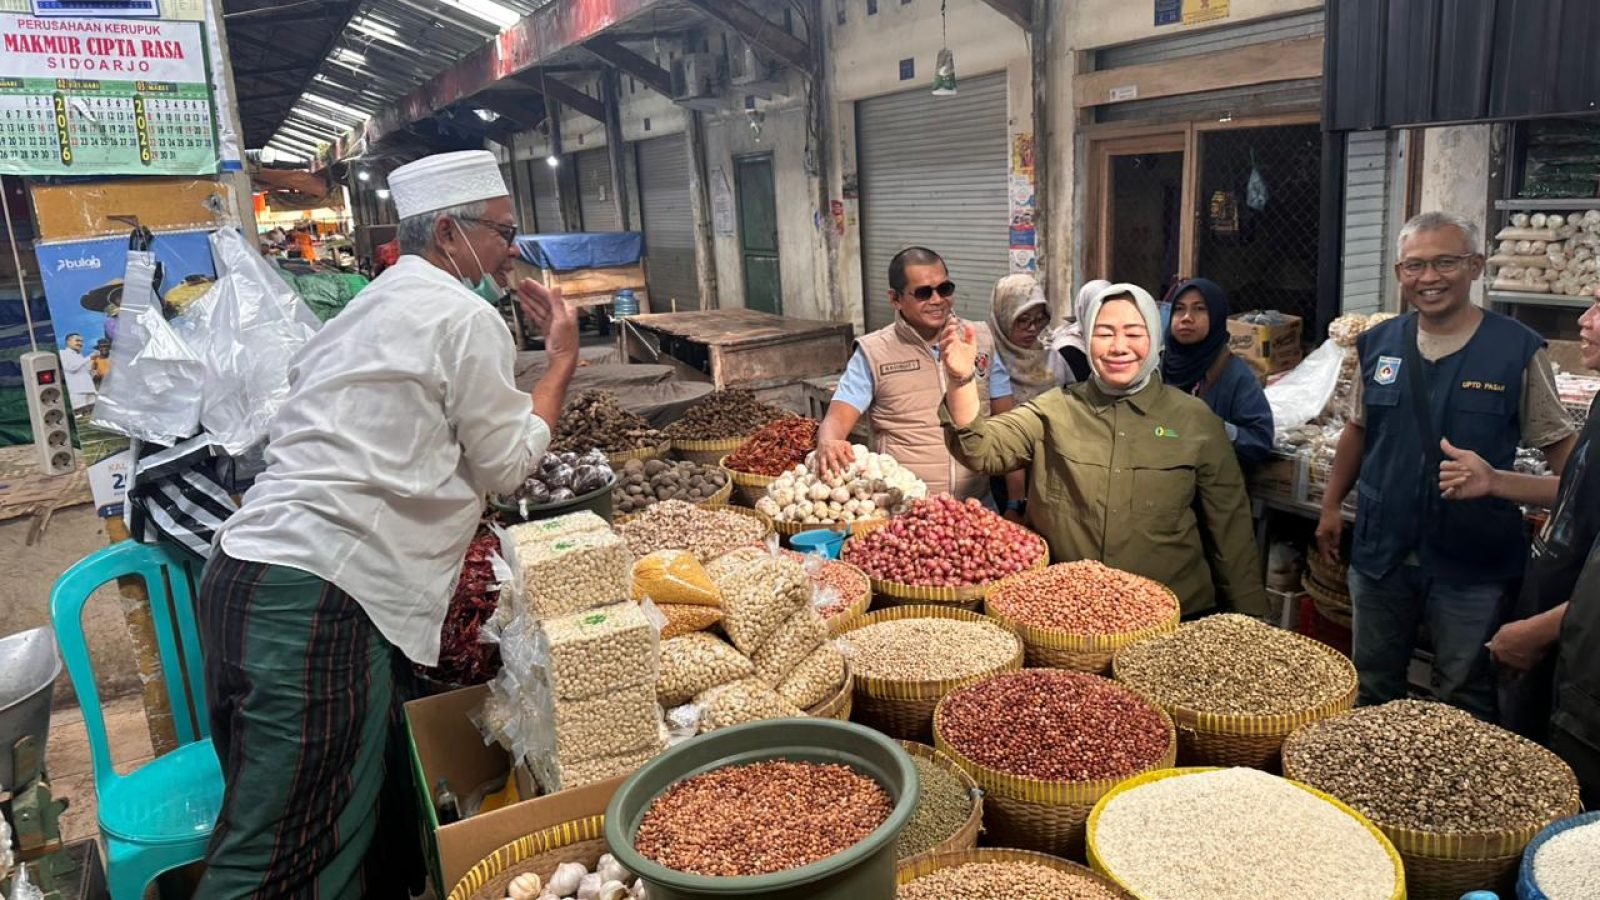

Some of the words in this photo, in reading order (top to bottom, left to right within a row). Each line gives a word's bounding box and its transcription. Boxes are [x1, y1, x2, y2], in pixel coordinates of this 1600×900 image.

[18, 20, 100, 32] PERUSAHAAN
[105, 24, 160, 35] KERUPUK
[4, 34, 81, 54] MAKMUR
[86, 37, 136, 57] CIPTA
[141, 40, 184, 59] RASA
[47, 58, 150, 71] SIDOARJO
[55, 98, 70, 160] 2026
[135, 100, 150, 160] 2026
[112, 473, 127, 490] 2
